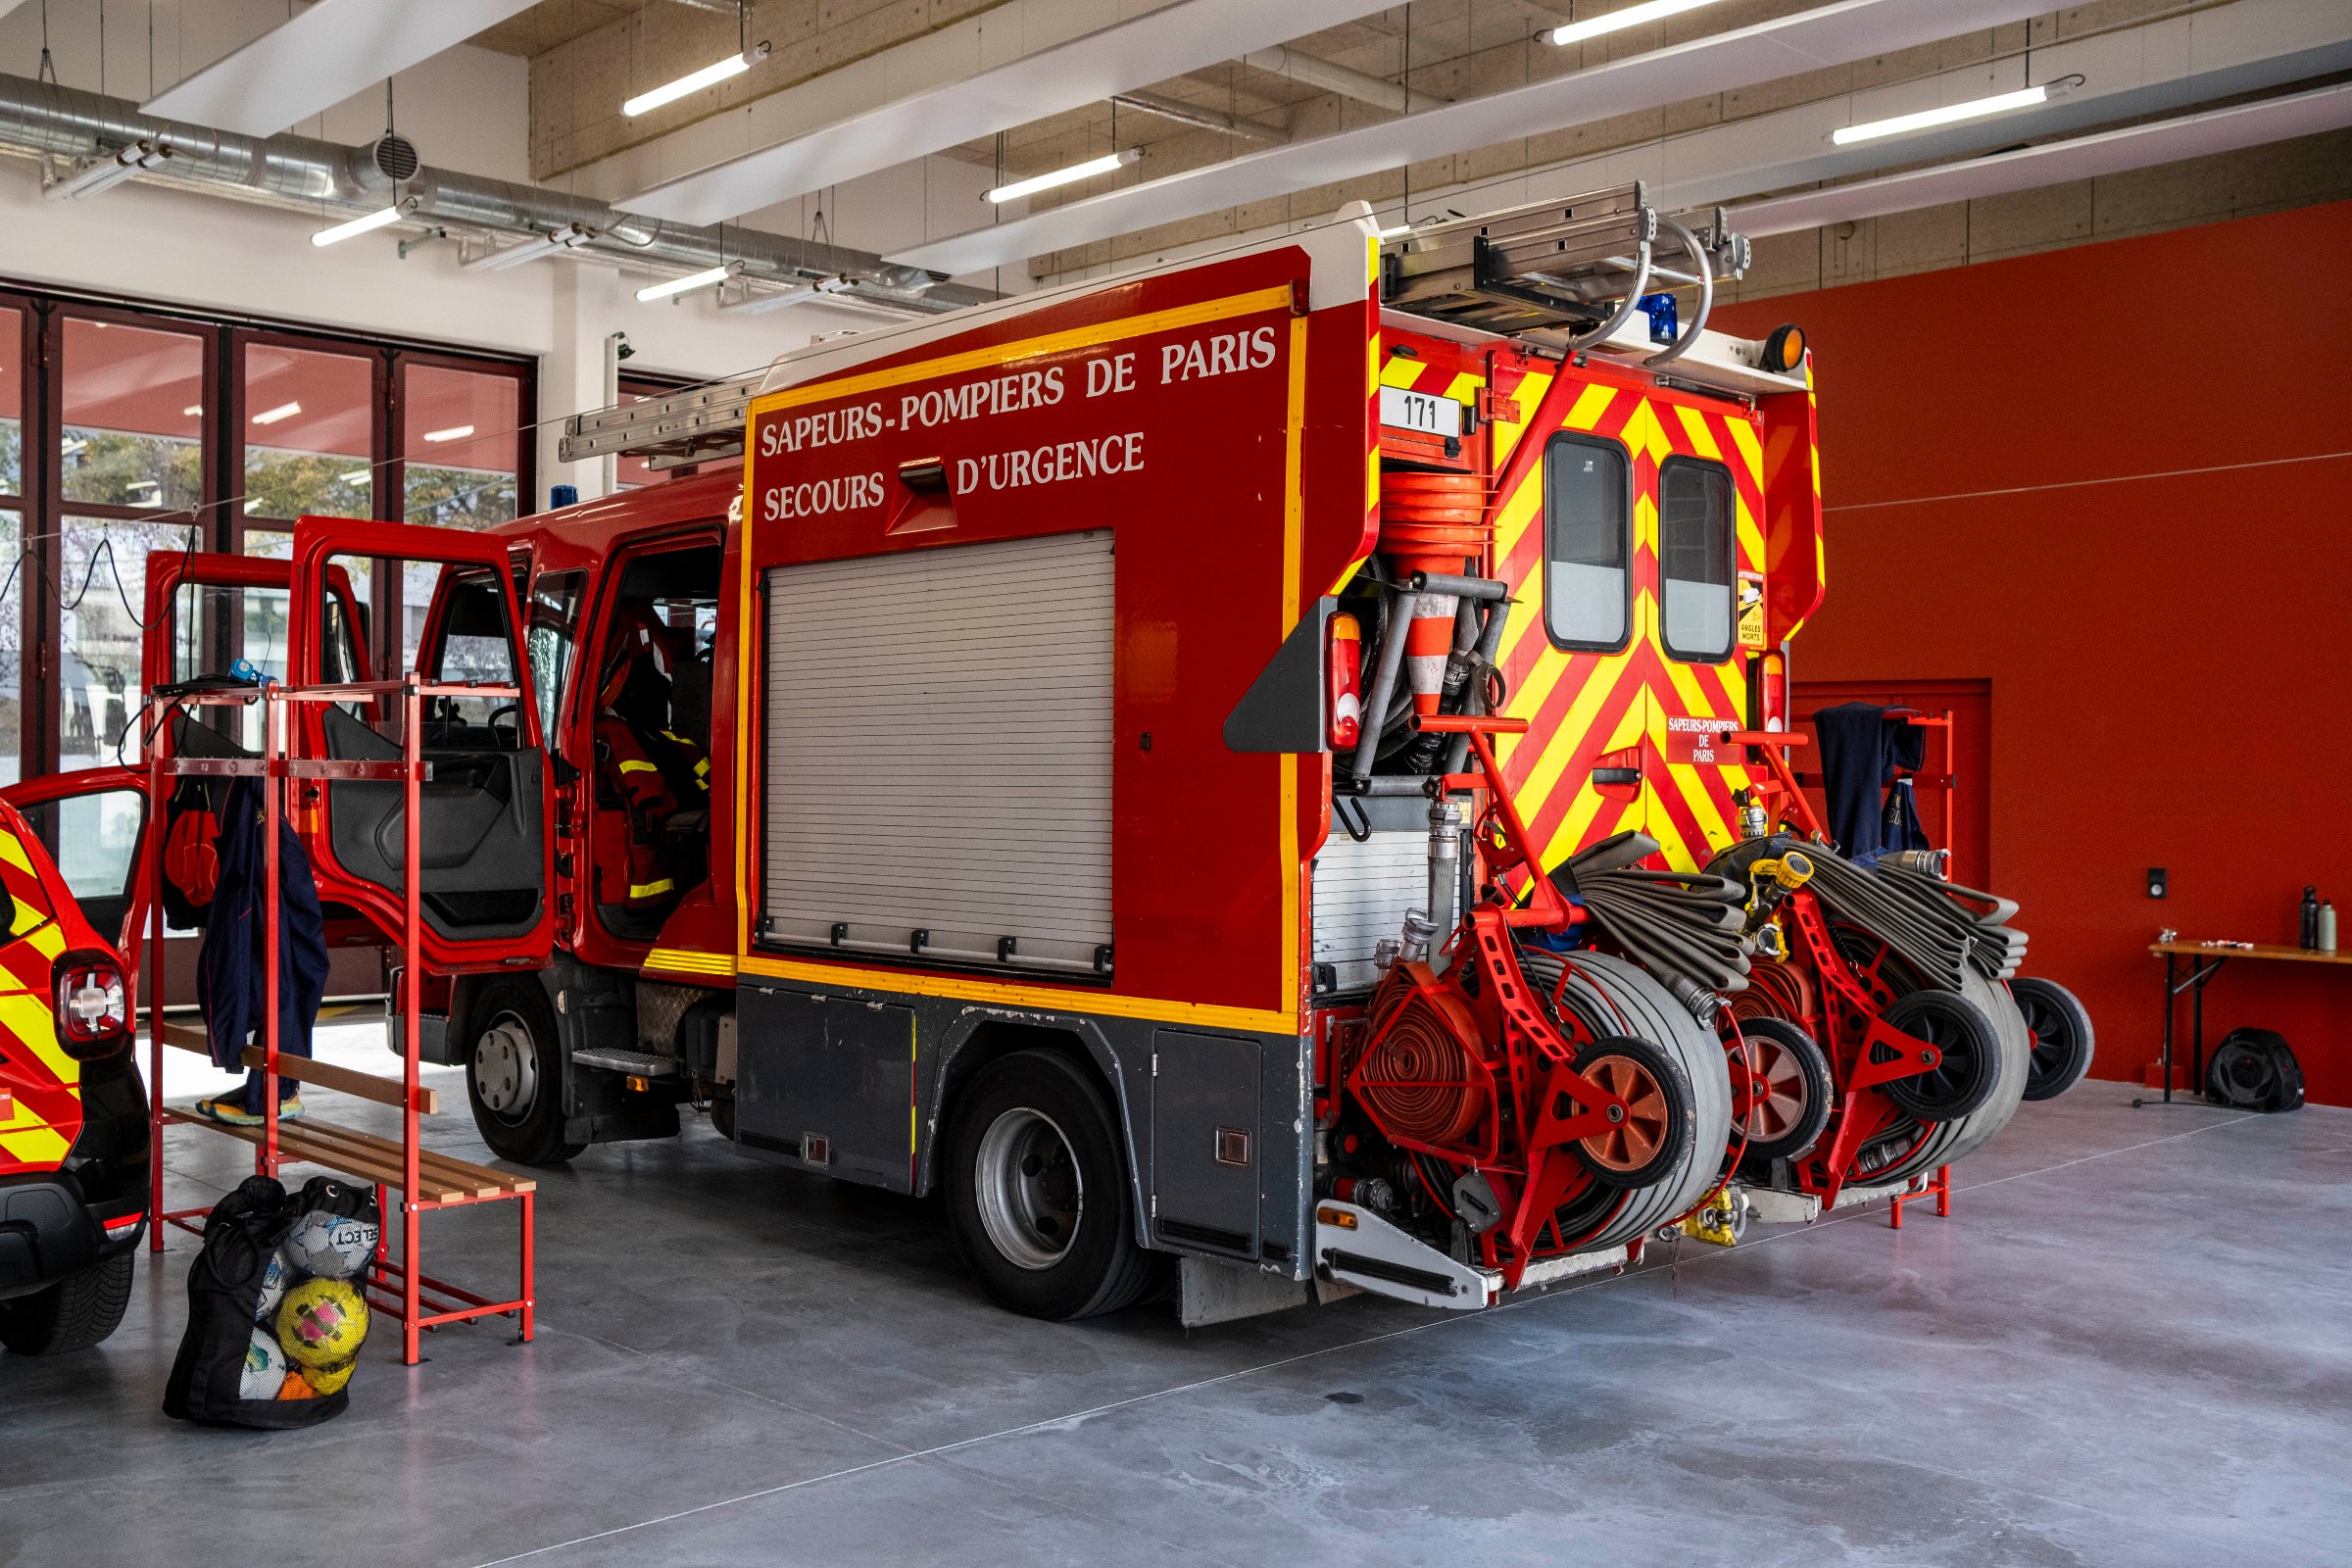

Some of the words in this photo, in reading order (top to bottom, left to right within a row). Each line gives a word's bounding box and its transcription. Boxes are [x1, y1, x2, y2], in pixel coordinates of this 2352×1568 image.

[761, 367, 1064, 458] SAPEURS-POMPIERS
[1086, 353, 1135, 398] DE
[1159, 326, 1276, 385] PARIS
[1404, 395, 1436, 429] 171
[764, 472, 885, 521] SECOURS
[956, 431, 1145, 495] D'URGENCE
[1738, 570, 1764, 580] ATTENTION
[1740, 624, 1761, 633] ANGLES
[1741, 633, 1760, 642] MORTS
[1668, 717, 1739, 733] SAPEURS-POMPIERS
[1698, 734, 1709, 748] DE
[1692, 749, 1714, 762] PARIS
